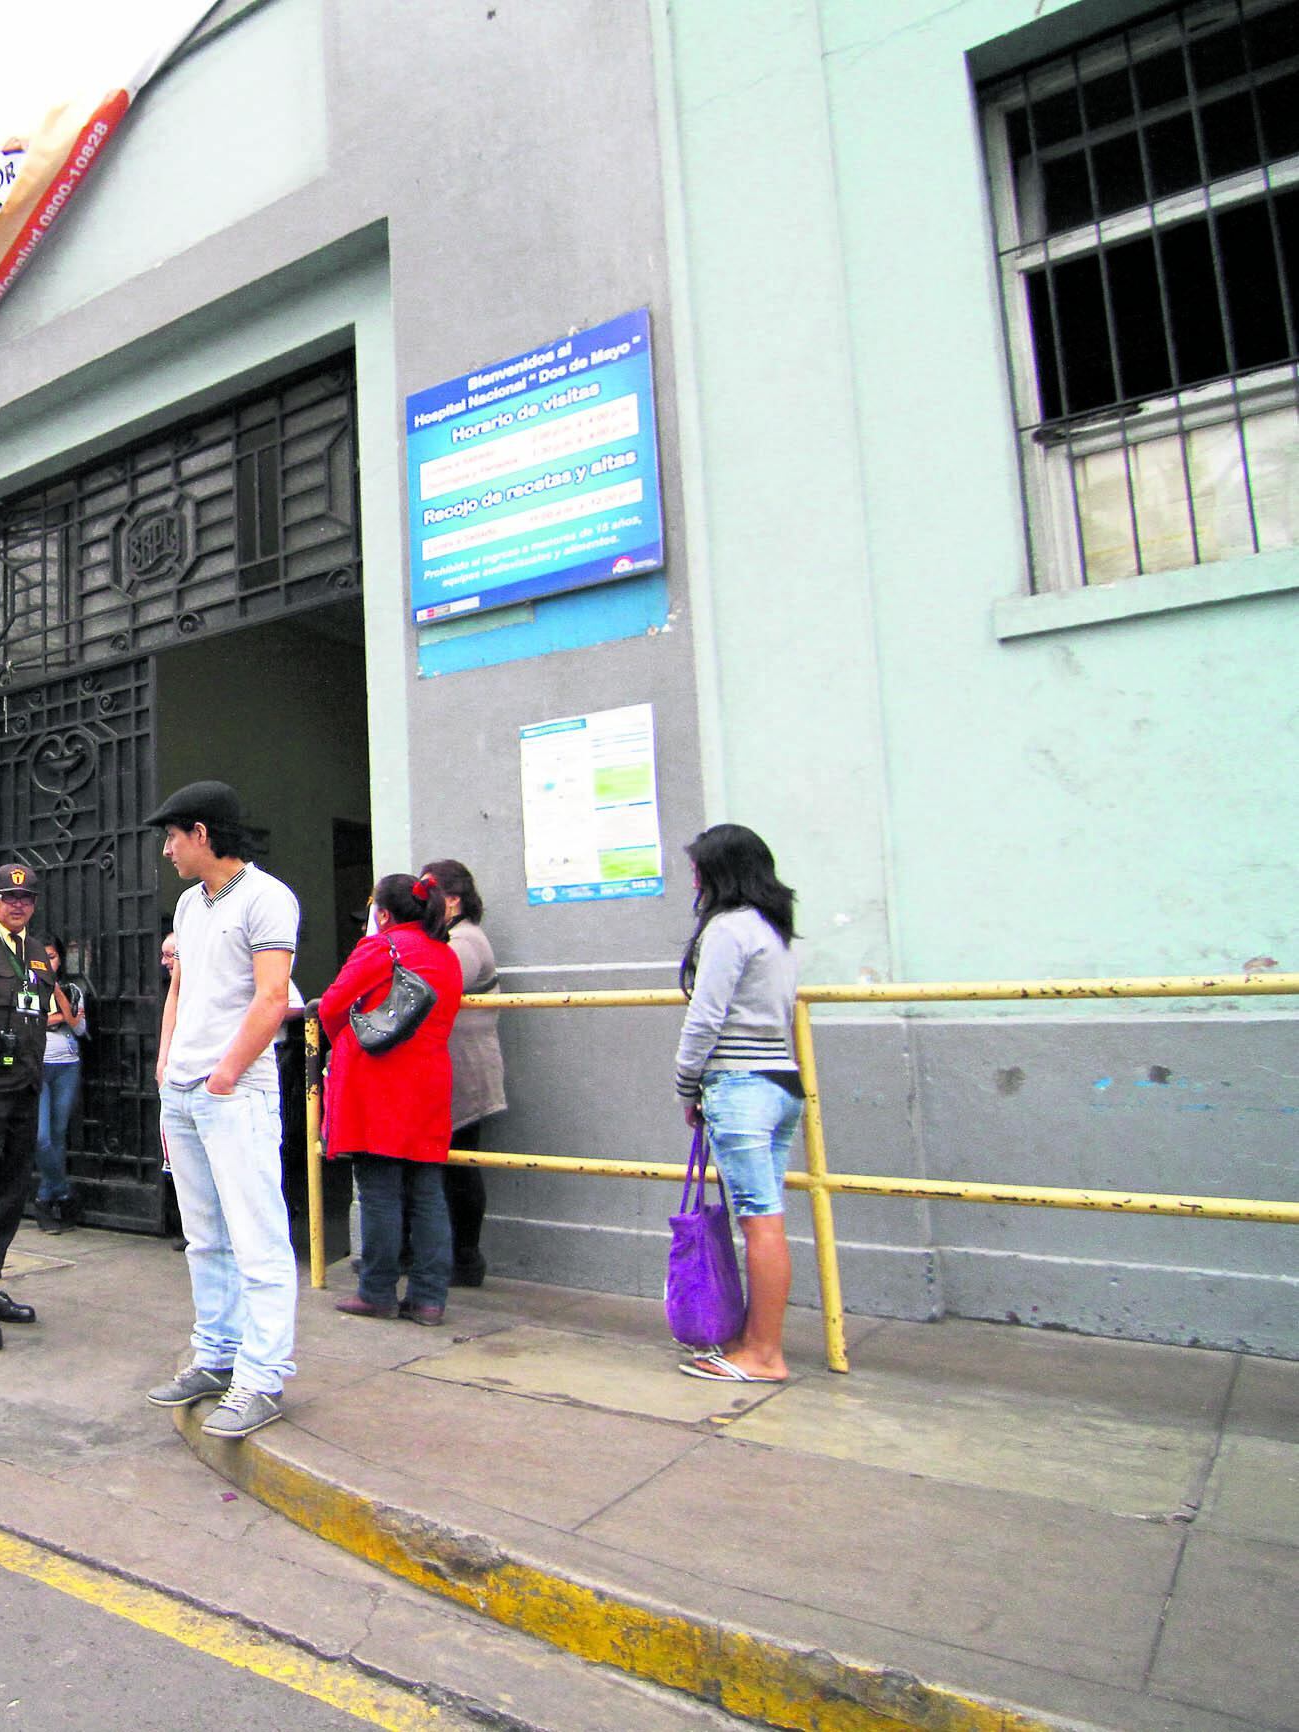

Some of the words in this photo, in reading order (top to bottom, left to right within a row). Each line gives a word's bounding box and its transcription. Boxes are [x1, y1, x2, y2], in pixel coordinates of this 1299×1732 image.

[39, 121, 109, 227] 0800-10828
[414, 398, 466, 428] Hospital
[468, 377, 527, 408] Nacional
[569, 357, 588, 373] de
[467, 350, 555, 392] Bienvenidos
[557, 341, 572, 359] al
[451, 411, 514, 445] Horario
[516, 403, 539, 421] de
[542, 382, 600, 412] visitas
[423, 498, 479, 526] Recojo
[481, 490, 504, 508] de
[505, 470, 573, 501] recetas
[575, 464, 588, 484] y
[590, 450, 638, 476] altas
